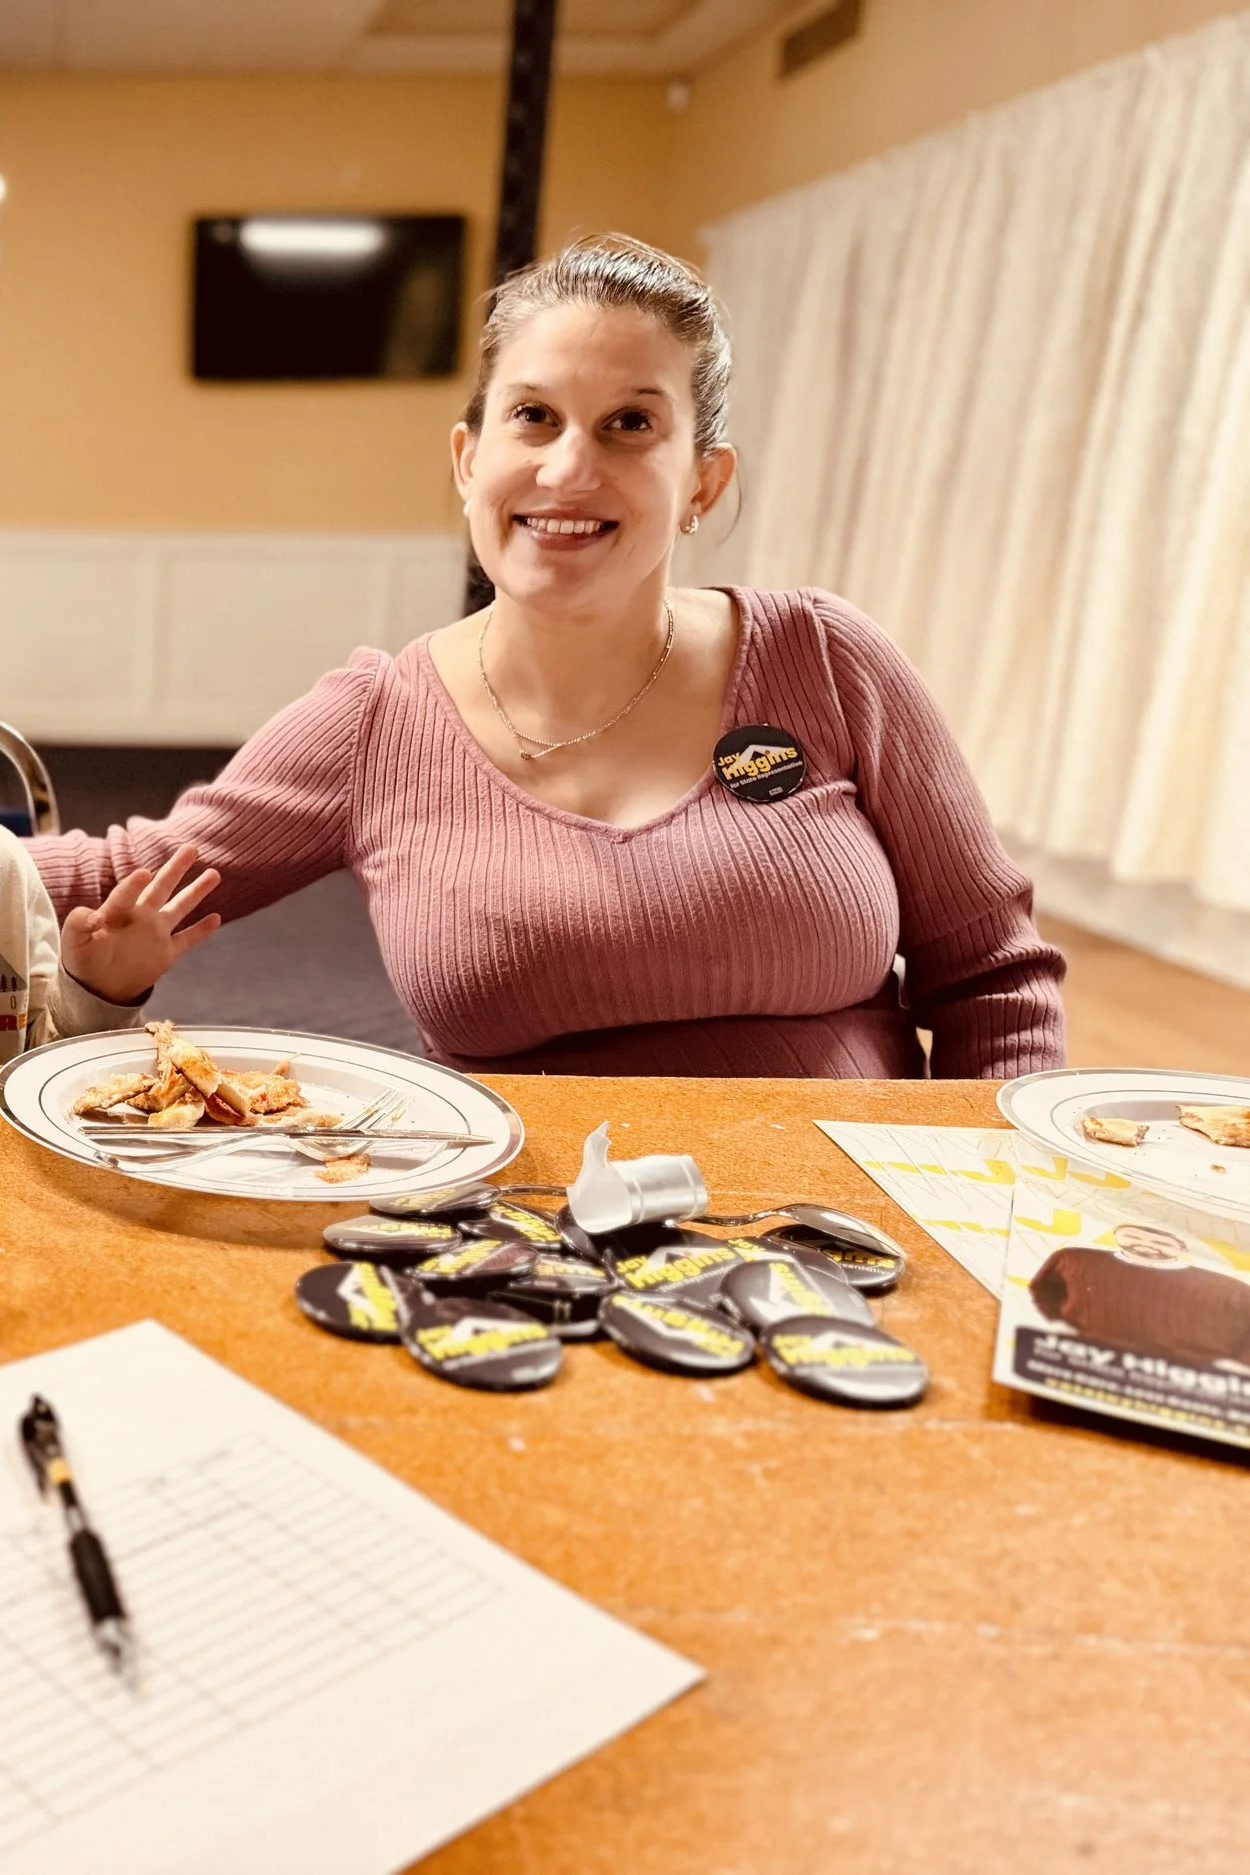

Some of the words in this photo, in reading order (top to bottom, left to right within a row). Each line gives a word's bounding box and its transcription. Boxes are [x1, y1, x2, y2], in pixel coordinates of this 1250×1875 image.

[718, 752, 740, 766] Jay
[722, 747, 798, 780] Higgins
[625, 1247, 735, 1288] Higgins
[1034, 1335, 1116, 1365] Jay
